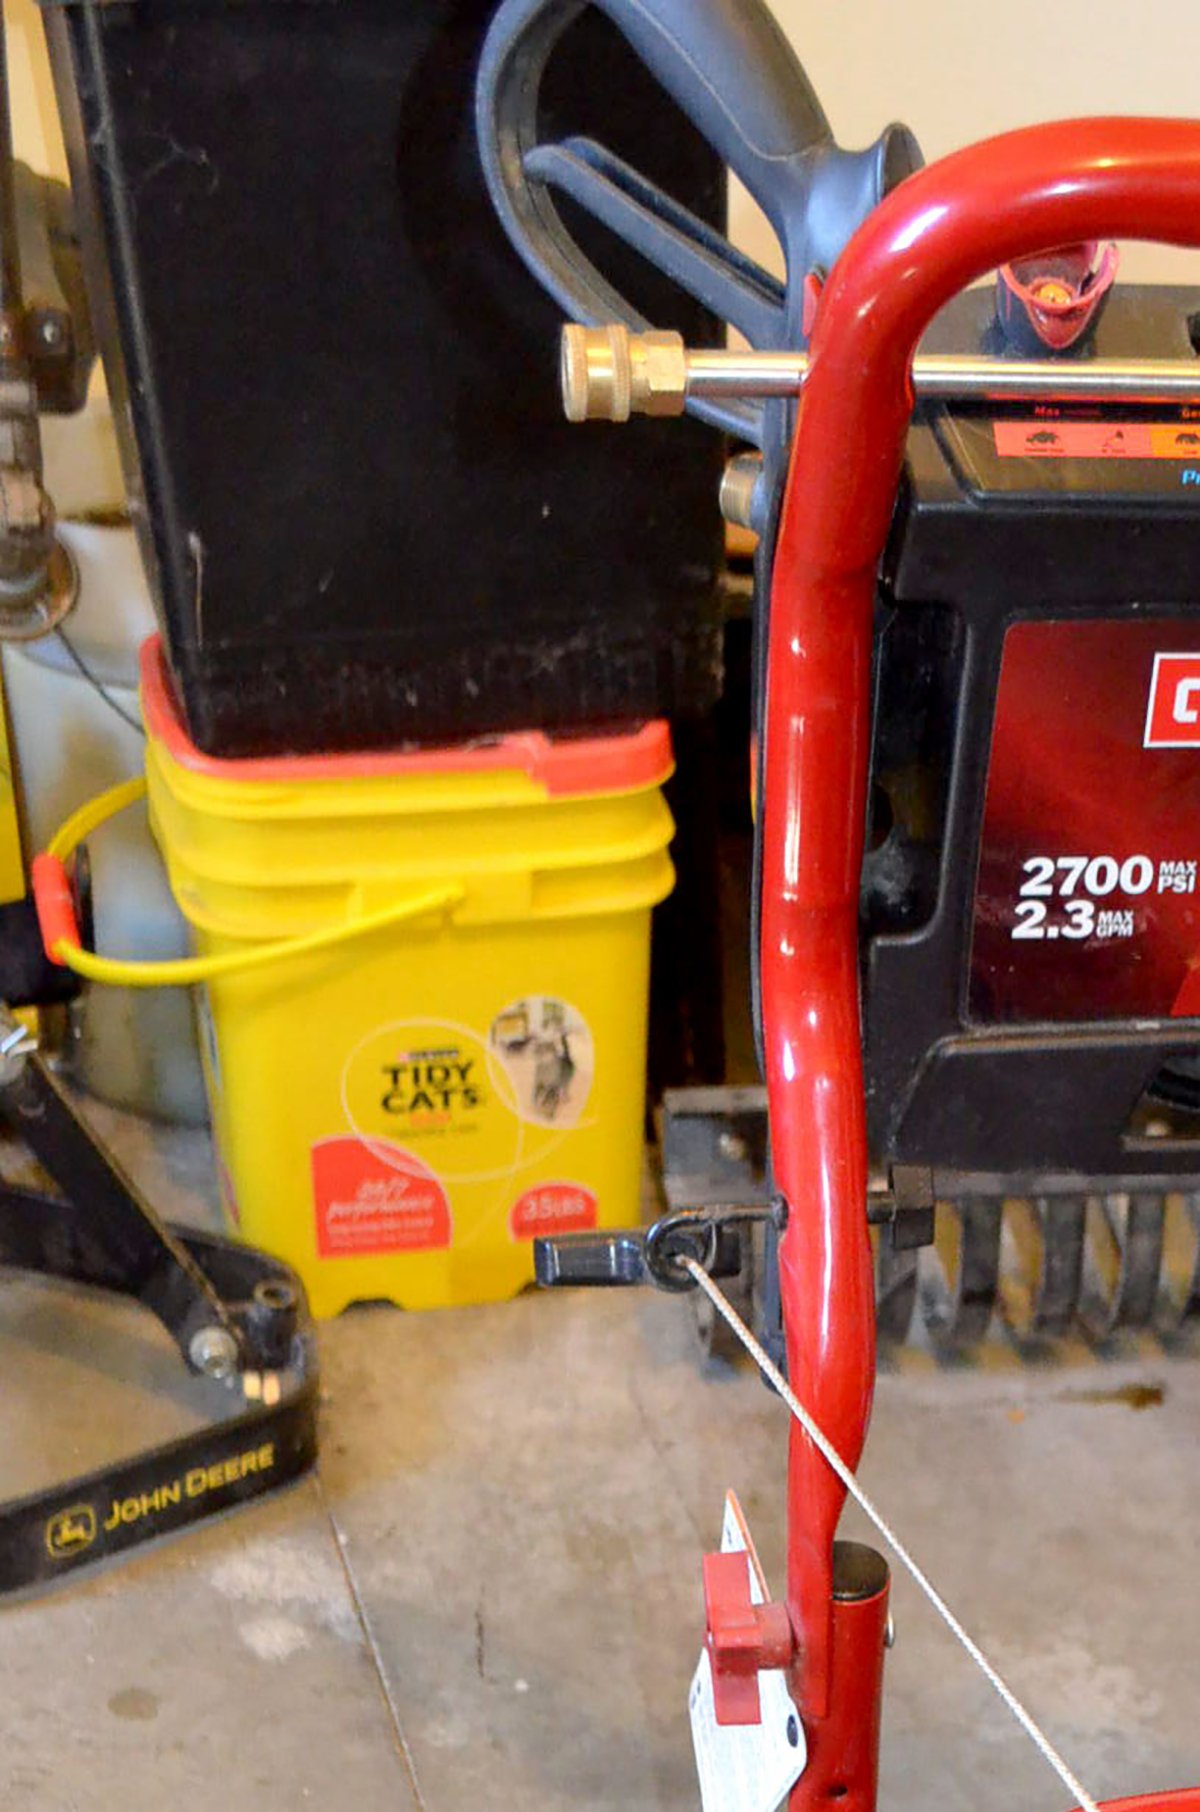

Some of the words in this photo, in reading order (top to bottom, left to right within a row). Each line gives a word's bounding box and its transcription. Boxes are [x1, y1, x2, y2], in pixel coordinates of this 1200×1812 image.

[1019, 854, 1154, 897] 2700
[1159, 860, 1198, 876] MAX
[1157, 874, 1196, 894] PSI
[1010, 899, 1095, 940] 2.3
[1096, 923, 1134, 938] GPM
[1098, 909, 1135, 925] MAX
[382, 1060, 474, 1091] TIDY
[381, 1087, 478, 1115] CATS
[104, 1479, 181, 1531] JOHN
[185, 1441, 275, 1497] DEERE
